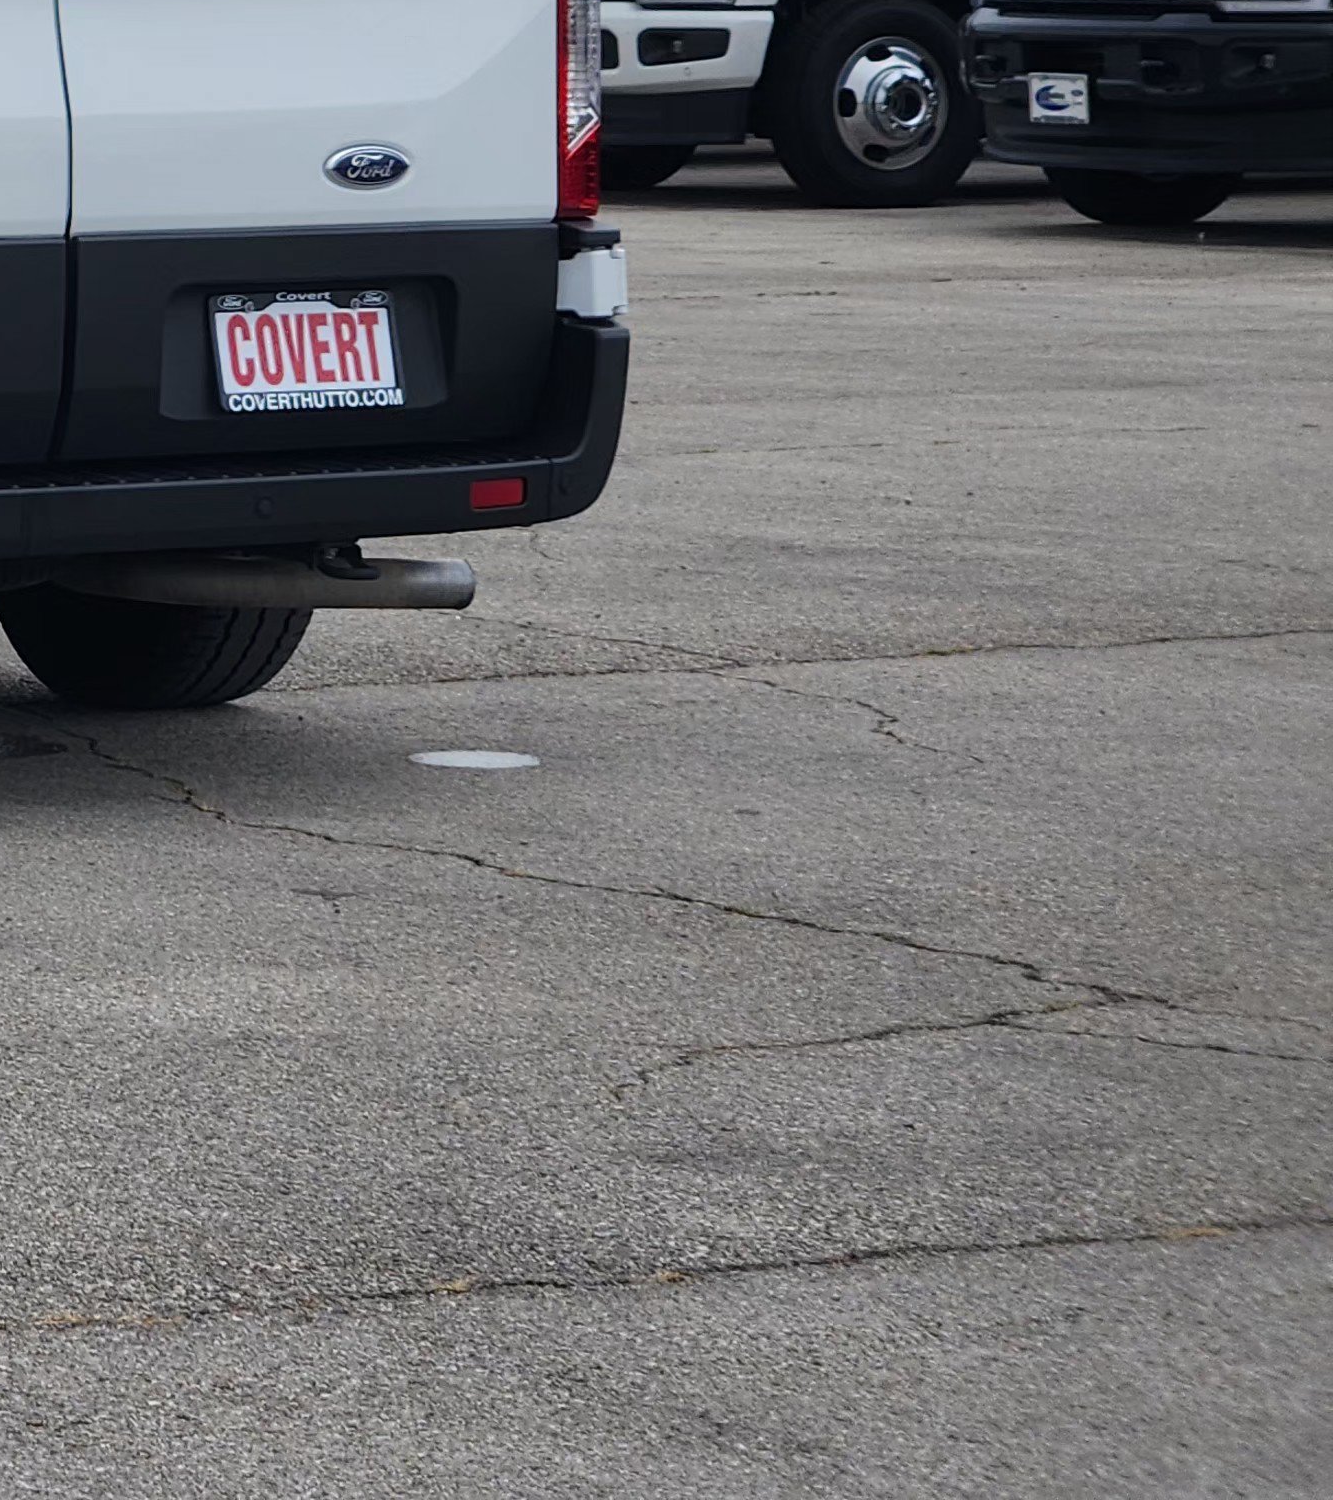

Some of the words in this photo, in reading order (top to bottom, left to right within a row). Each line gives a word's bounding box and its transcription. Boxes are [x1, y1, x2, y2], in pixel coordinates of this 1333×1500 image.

[346, 154, 395, 179] Ford
[275, 291, 332, 302] Covert
[227, 311, 381, 387] COVERT
[228, 388, 404, 412] COVERTHUTTO.COM
